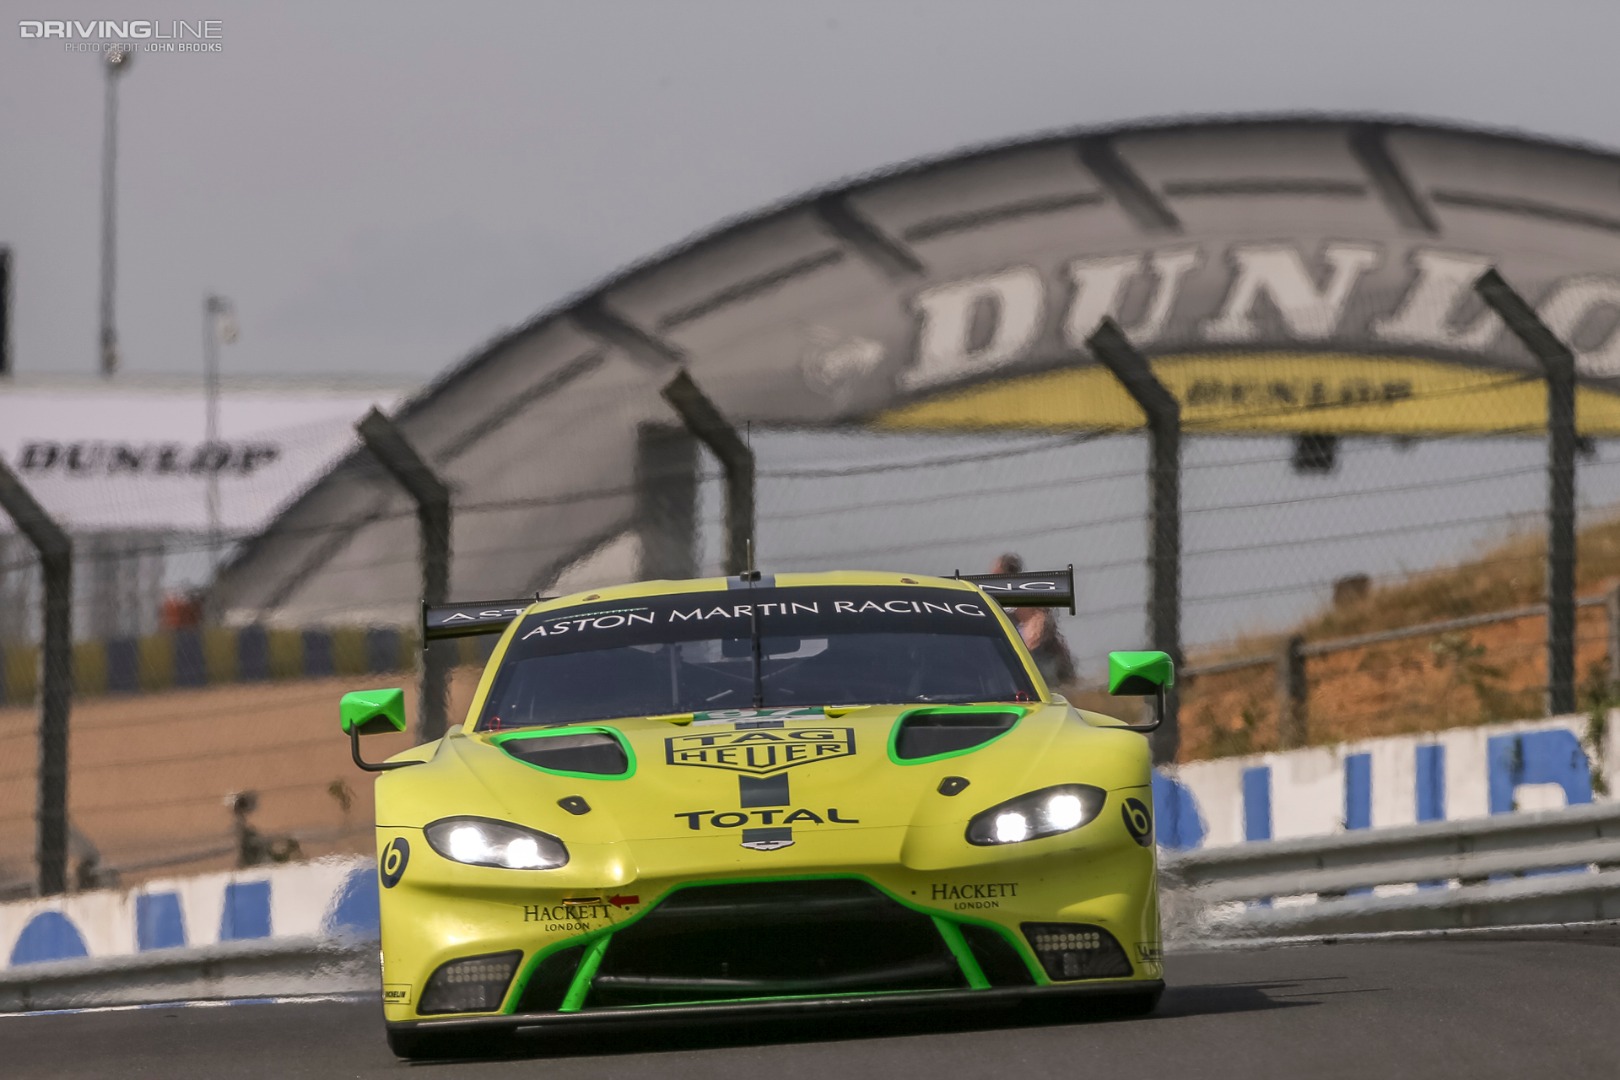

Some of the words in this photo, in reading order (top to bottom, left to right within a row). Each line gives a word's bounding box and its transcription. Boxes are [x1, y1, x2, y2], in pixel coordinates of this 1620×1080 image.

[18, 438, 281, 475] DUNLOP
[521, 611, 655, 640] ASTON
[668, 604, 819, 624] MARTIN
[833, 600, 986, 617] RACING
[683, 730, 834, 746] TAG
[681, 744, 842, 768] HEUER
[674, 808, 860, 831] TOTAL
[931, 882, 1018, 900] HACKETT
[523, 904, 611, 922] HACKETT
[954, 900, 999, 910] LONDON
[545, 922, 590, 932] LONDON
